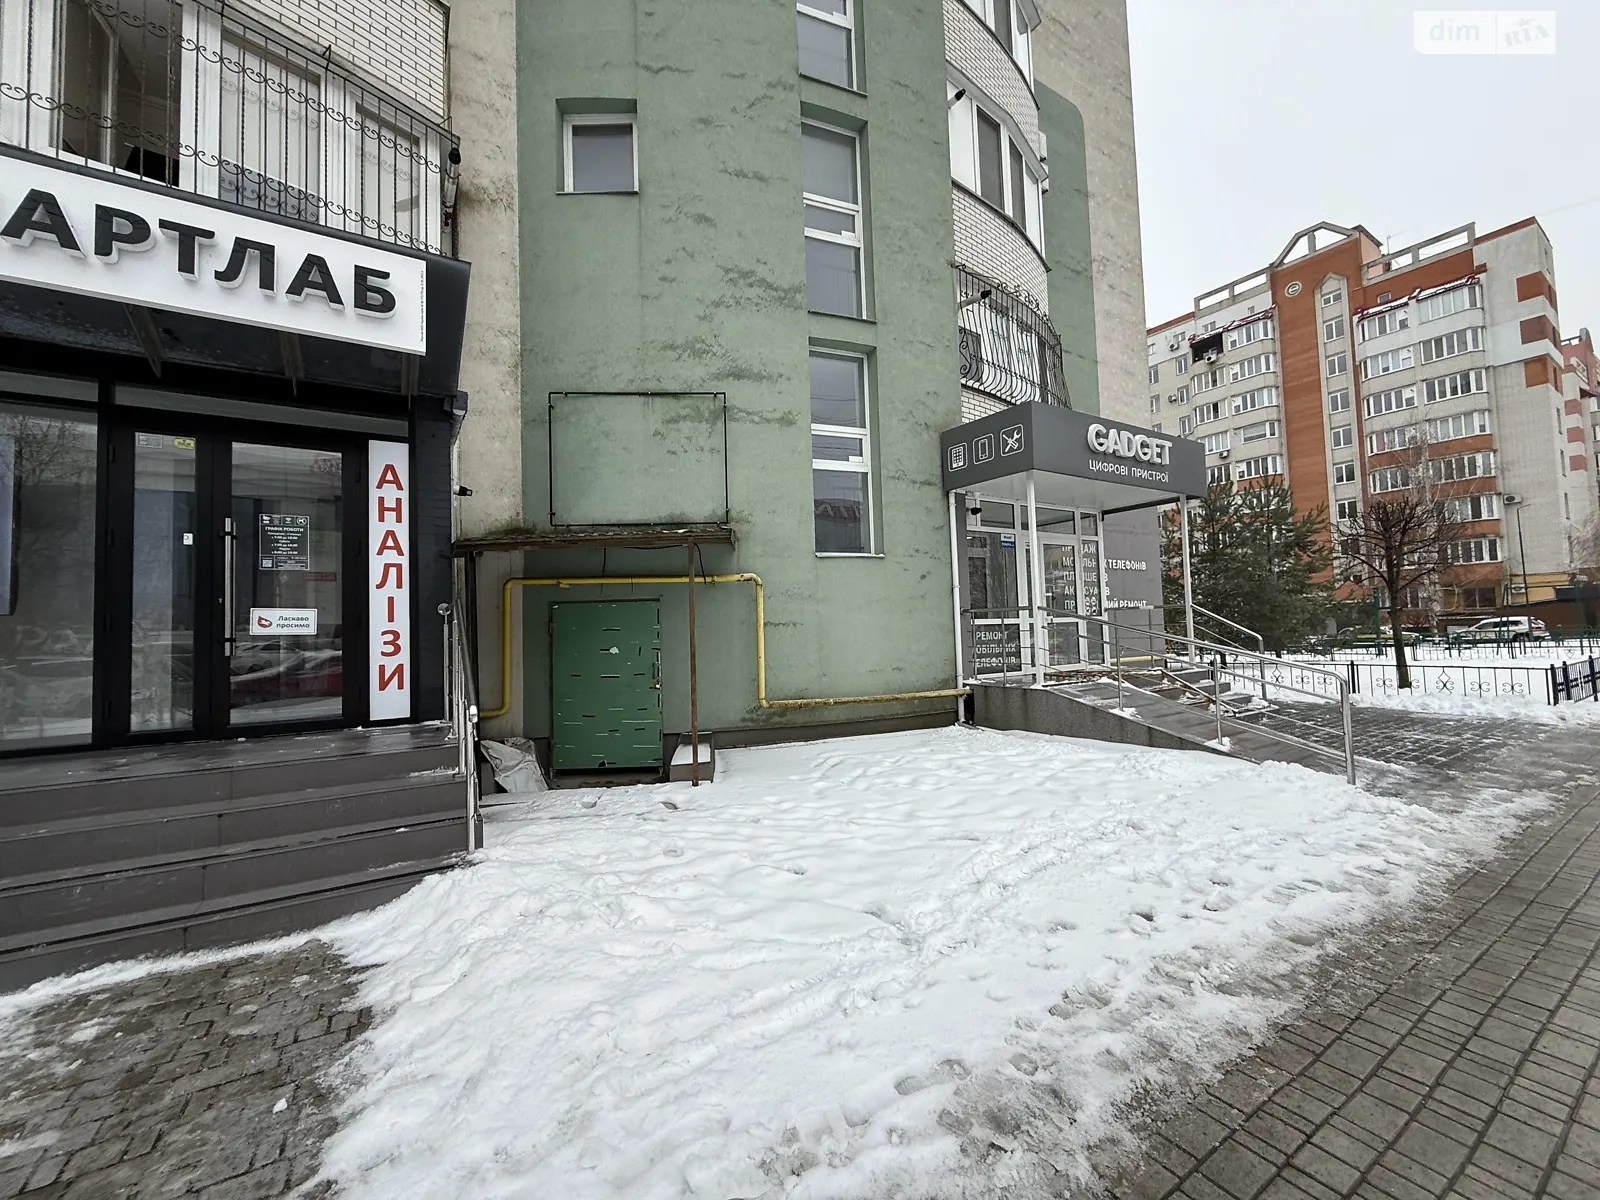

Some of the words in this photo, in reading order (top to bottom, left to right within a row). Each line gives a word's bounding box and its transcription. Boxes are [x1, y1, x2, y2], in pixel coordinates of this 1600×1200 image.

[0, 187, 398, 318] АРТЛАБ
[1087, 423, 1173, 465] GADGET
[1089, 459, 1128, 476] ЦИФРОВІ
[1131, 467, 1169, 483] ПРИСТРОЇ
[375, 463, 405, 693] АНАЛІЗИ
[1107, 558, 1147, 571] ТЕЛЕФОНІВ
